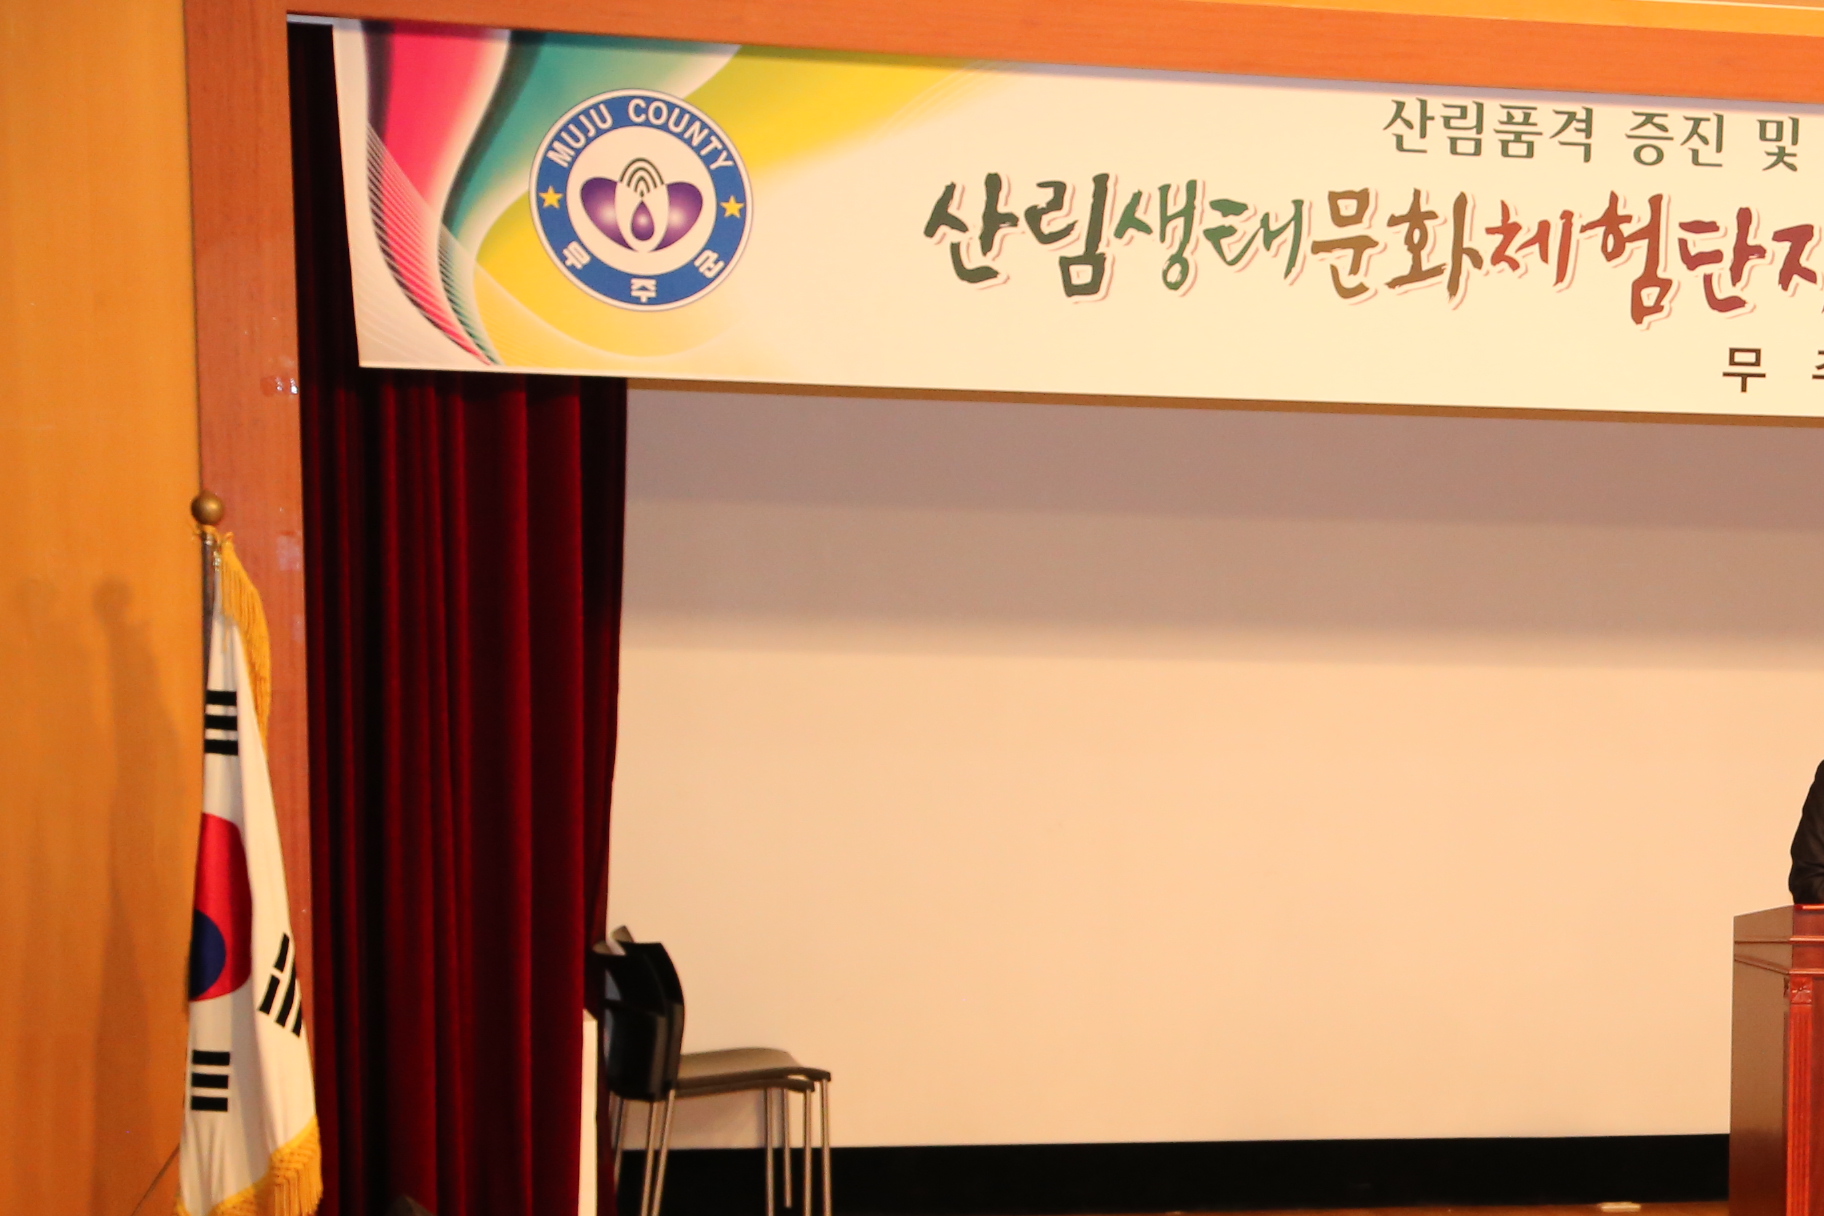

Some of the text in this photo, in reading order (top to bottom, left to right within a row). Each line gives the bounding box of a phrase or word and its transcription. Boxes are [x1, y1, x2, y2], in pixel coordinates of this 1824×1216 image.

[546, 97, 735, 171] MUJU COUNTY
[1382, 97, 1594, 163] 산림품격
[1625, 109, 1725, 169] 증진
[1757, 114, 1800, 172] 및
